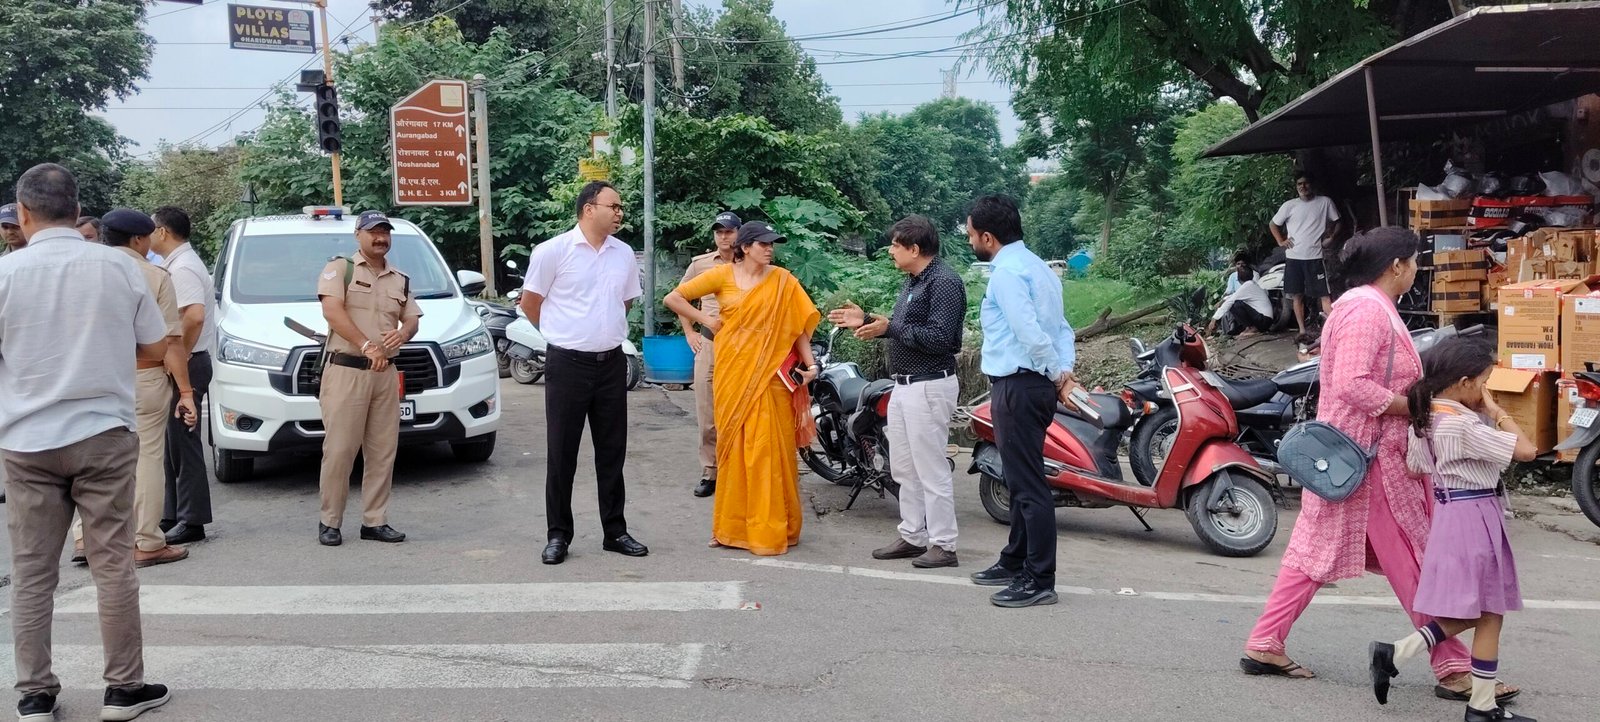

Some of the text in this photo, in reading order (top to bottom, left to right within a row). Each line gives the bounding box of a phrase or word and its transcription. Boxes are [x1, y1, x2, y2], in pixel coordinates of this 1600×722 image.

[237, 7, 284, 21] PLOTS
[233, 23, 289, 38] VILLAS
[396, 119, 428, 127] औरंगाबाद
[396, 132, 438, 140] Aurangabad
[398, 148, 429, 156] रोशनाबाद
